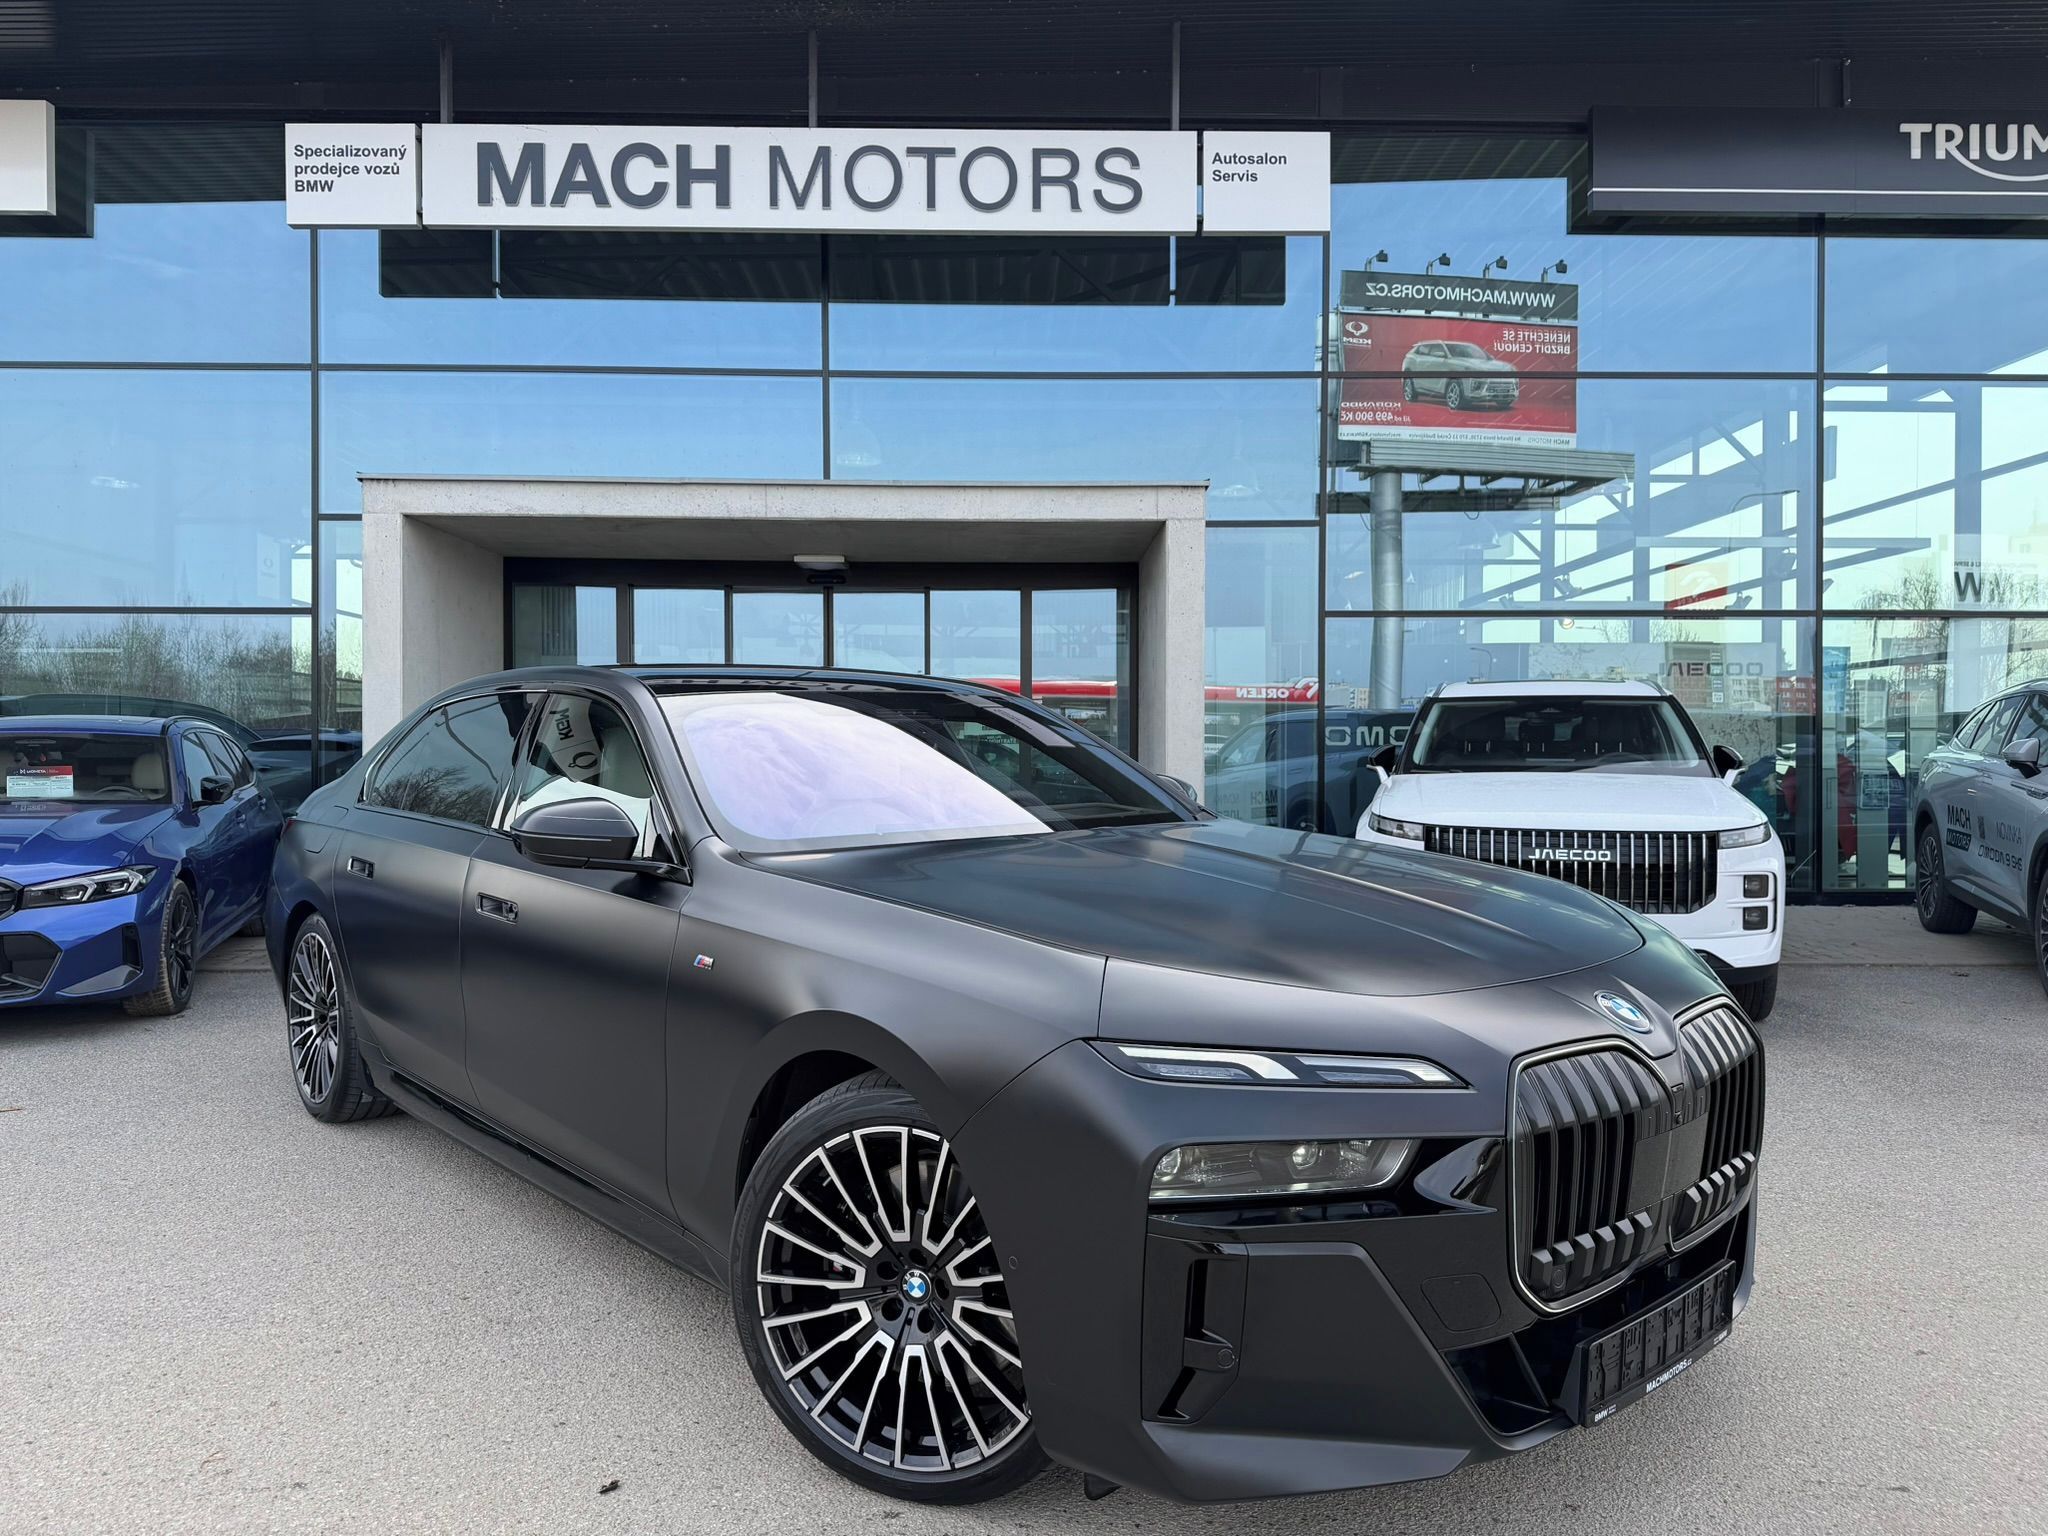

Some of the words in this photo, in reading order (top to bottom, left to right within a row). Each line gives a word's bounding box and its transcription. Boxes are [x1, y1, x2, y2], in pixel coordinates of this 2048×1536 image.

[293, 144, 407, 160] Specializovaný
[1211, 152, 1288, 165] Autosalon
[1900, 123, 2048, 181] TRIUM
[294, 162, 361, 178] prodejce
[364, 162, 400, 175] vozů
[476, 141, 731, 209] MACH
[768, 144, 1143, 214] MOTORS
[1211, 169, 1259, 182] Servis
[294, 180, 334, 193] BMW
[1947, 804, 1971, 830] MACH
[1528, 848, 1611, 861] JAECOO
